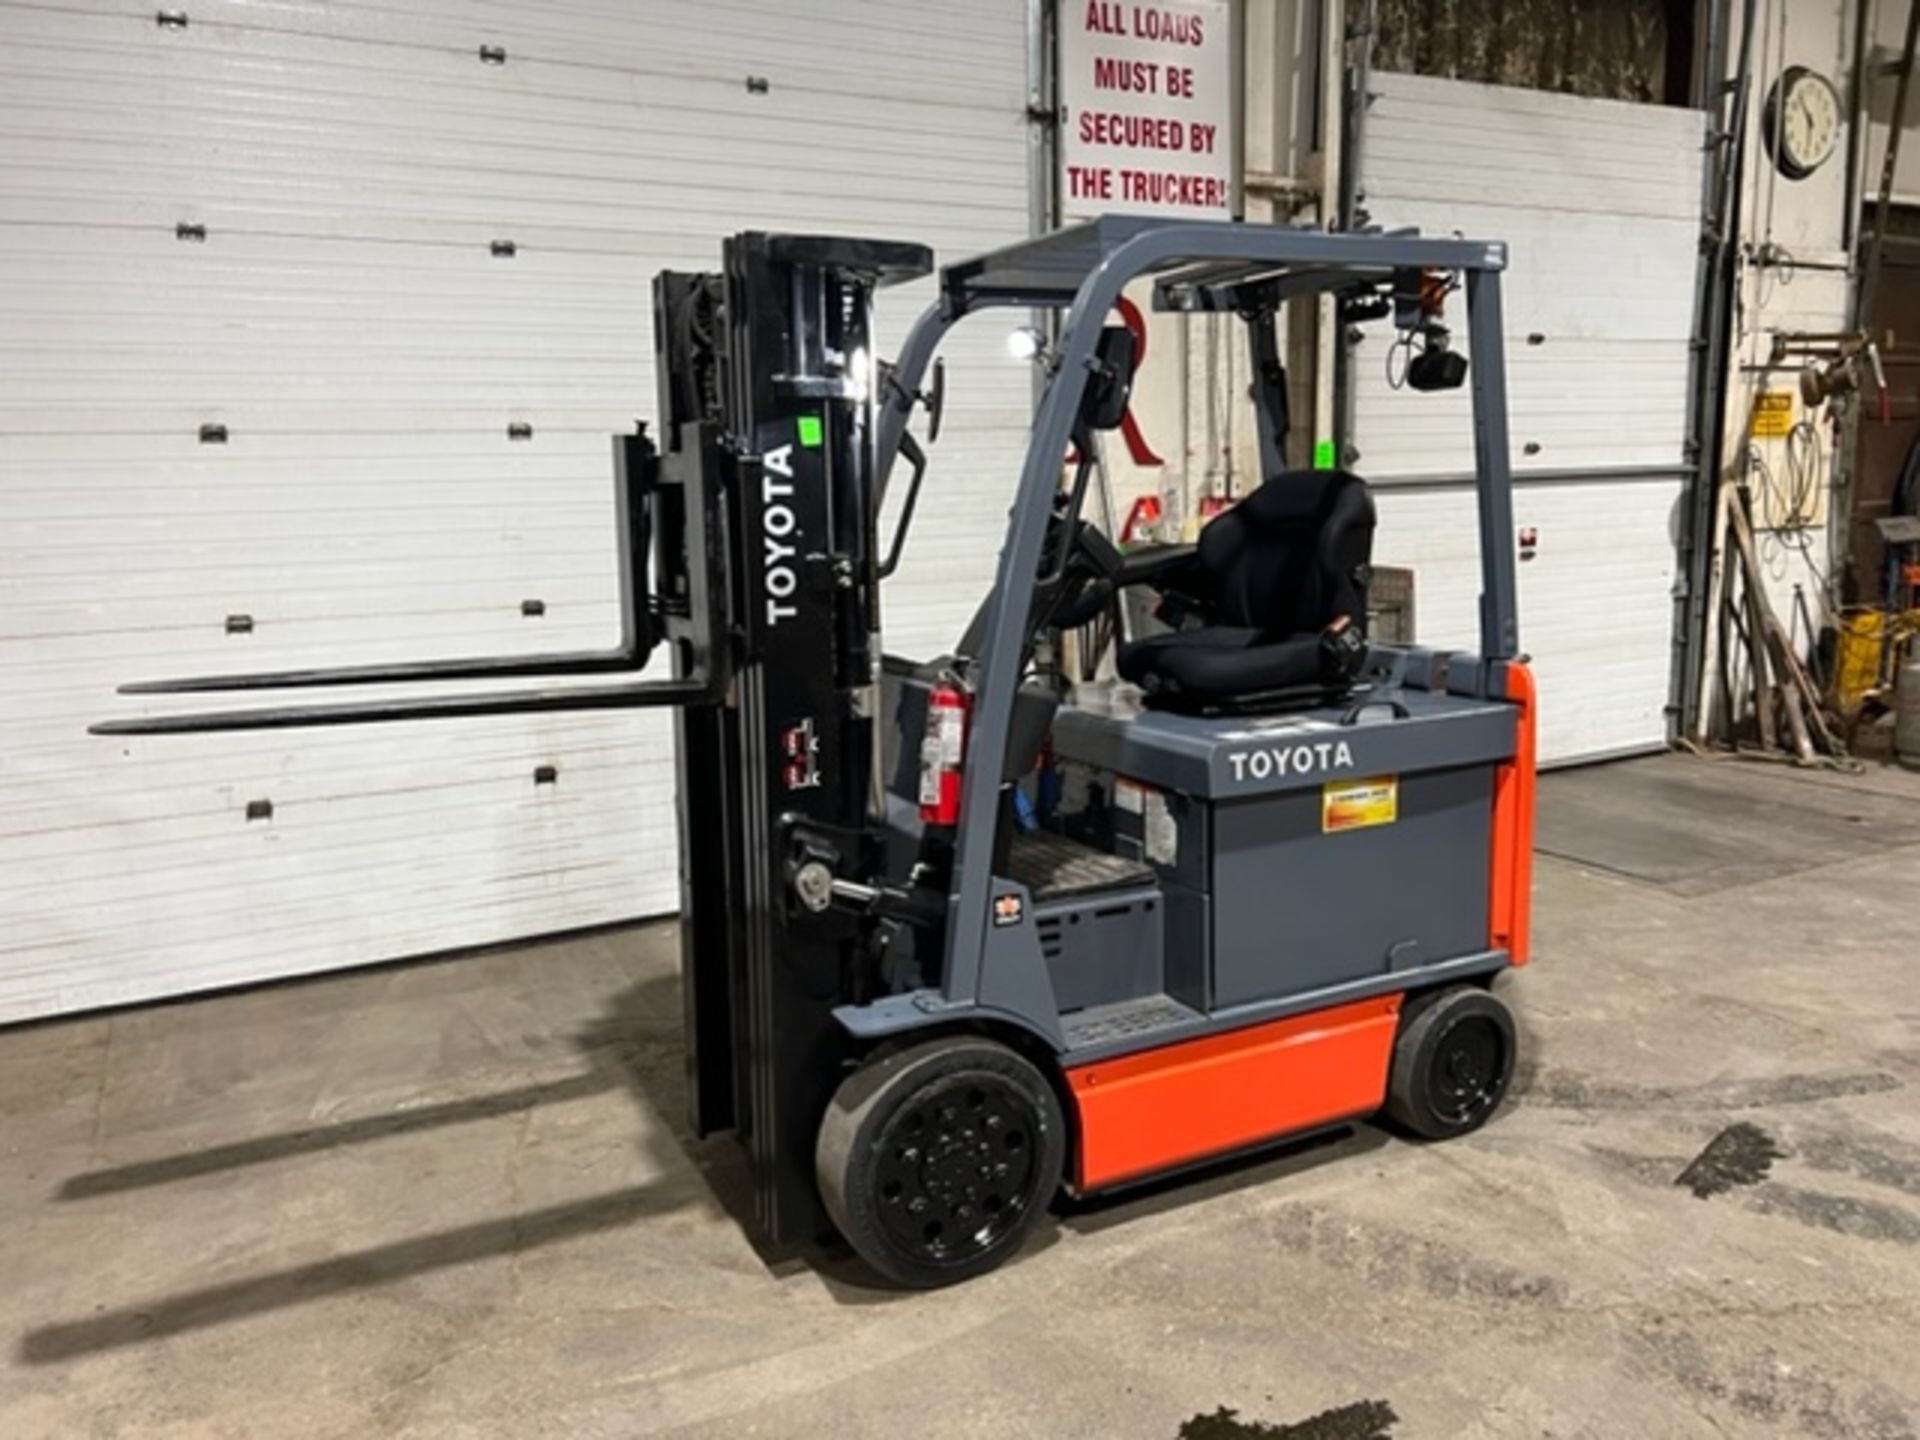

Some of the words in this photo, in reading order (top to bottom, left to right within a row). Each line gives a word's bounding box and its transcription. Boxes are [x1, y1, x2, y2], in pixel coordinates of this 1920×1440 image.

[1085, 0, 1126, 35] ALL
[1134, 8, 1203, 46] LOADS
[1094, 57, 1158, 93] MUST
[1166, 66, 1194, 98] BE
[1079, 110, 1183, 150] SECURED
[1190, 123, 1216, 154] BY
[1067, 167, 1111, 199] THE
[1120, 170, 1226, 207] TRUCKER!
[762, 443, 797, 626] TOYOTA
[1229, 741, 1354, 781] TOYOTA
